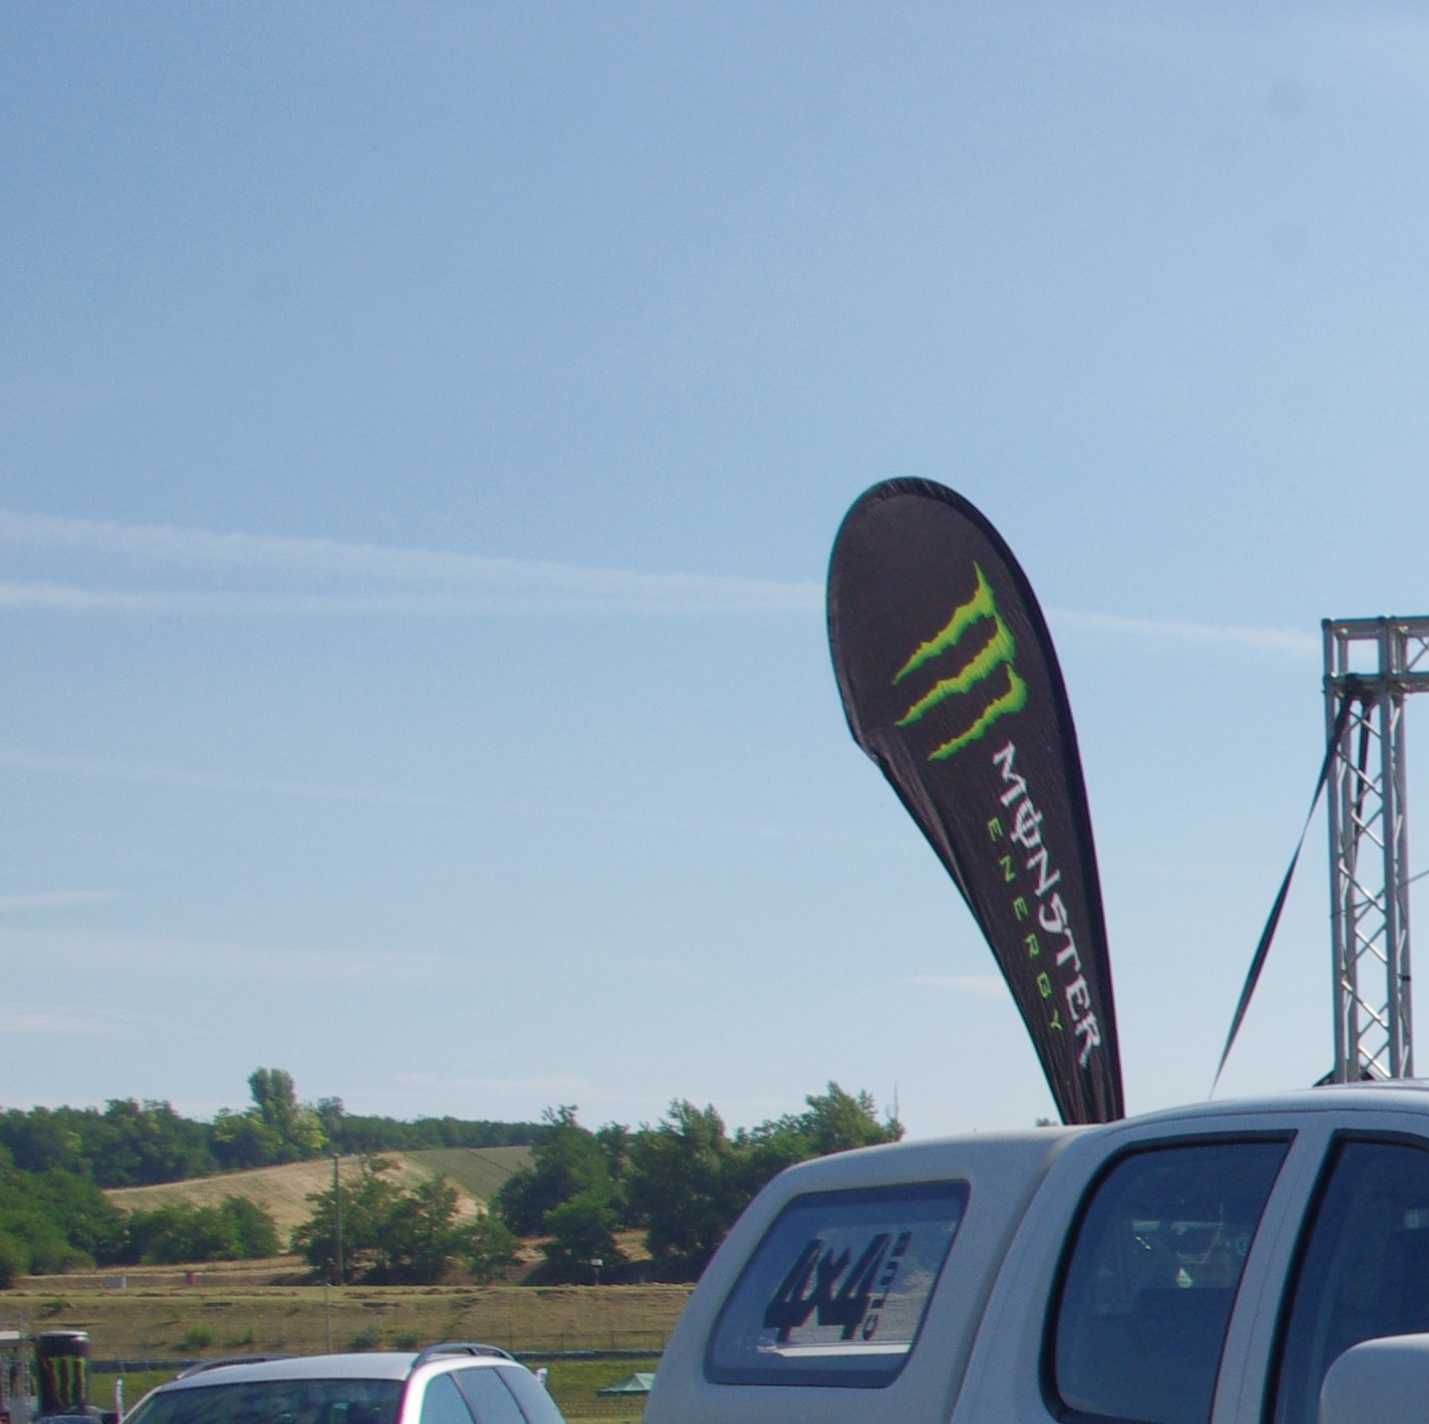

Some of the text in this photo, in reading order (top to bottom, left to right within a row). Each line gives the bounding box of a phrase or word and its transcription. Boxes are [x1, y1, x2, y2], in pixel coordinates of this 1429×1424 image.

[987, 816, 1065, 1033] ENERGY
[993, 741, 1102, 1069] MONSTER
[763, 1232, 892, 1343] 4x4
